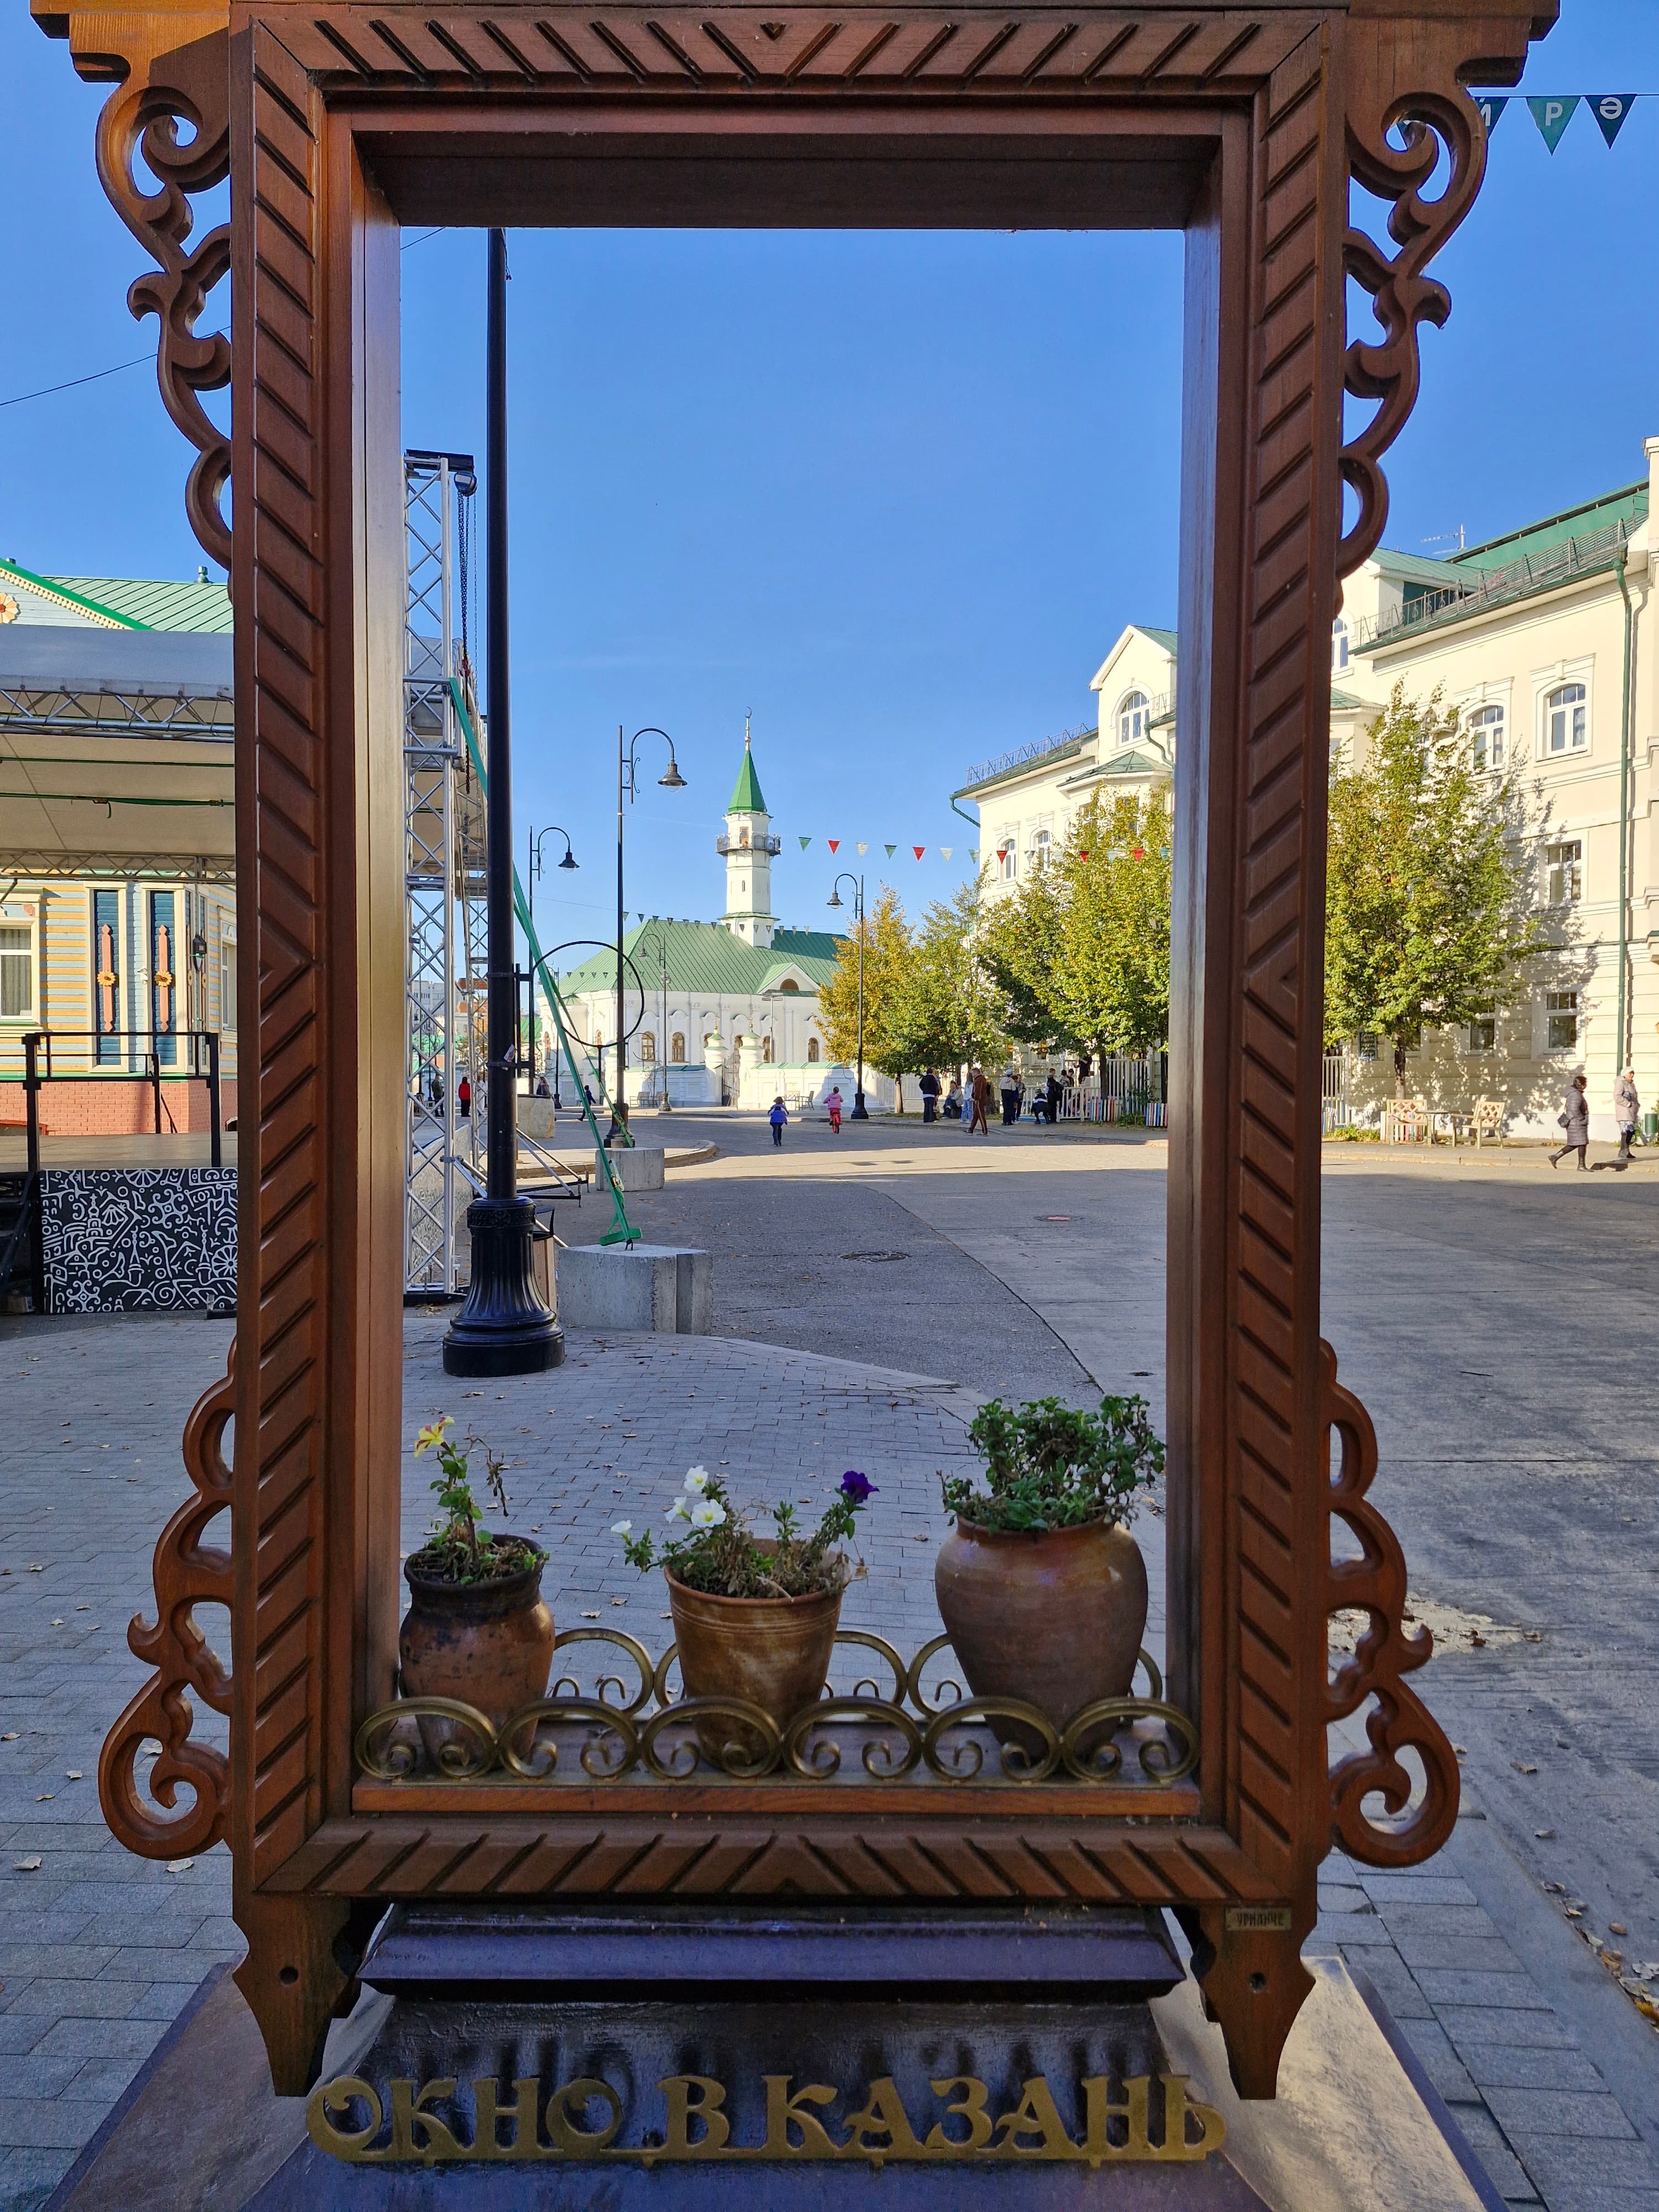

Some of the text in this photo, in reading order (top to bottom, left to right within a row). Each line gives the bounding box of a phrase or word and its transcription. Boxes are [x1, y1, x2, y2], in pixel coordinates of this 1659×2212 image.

[306, 2075, 1227, 2160] ОКНО В КАЗАНЬ
